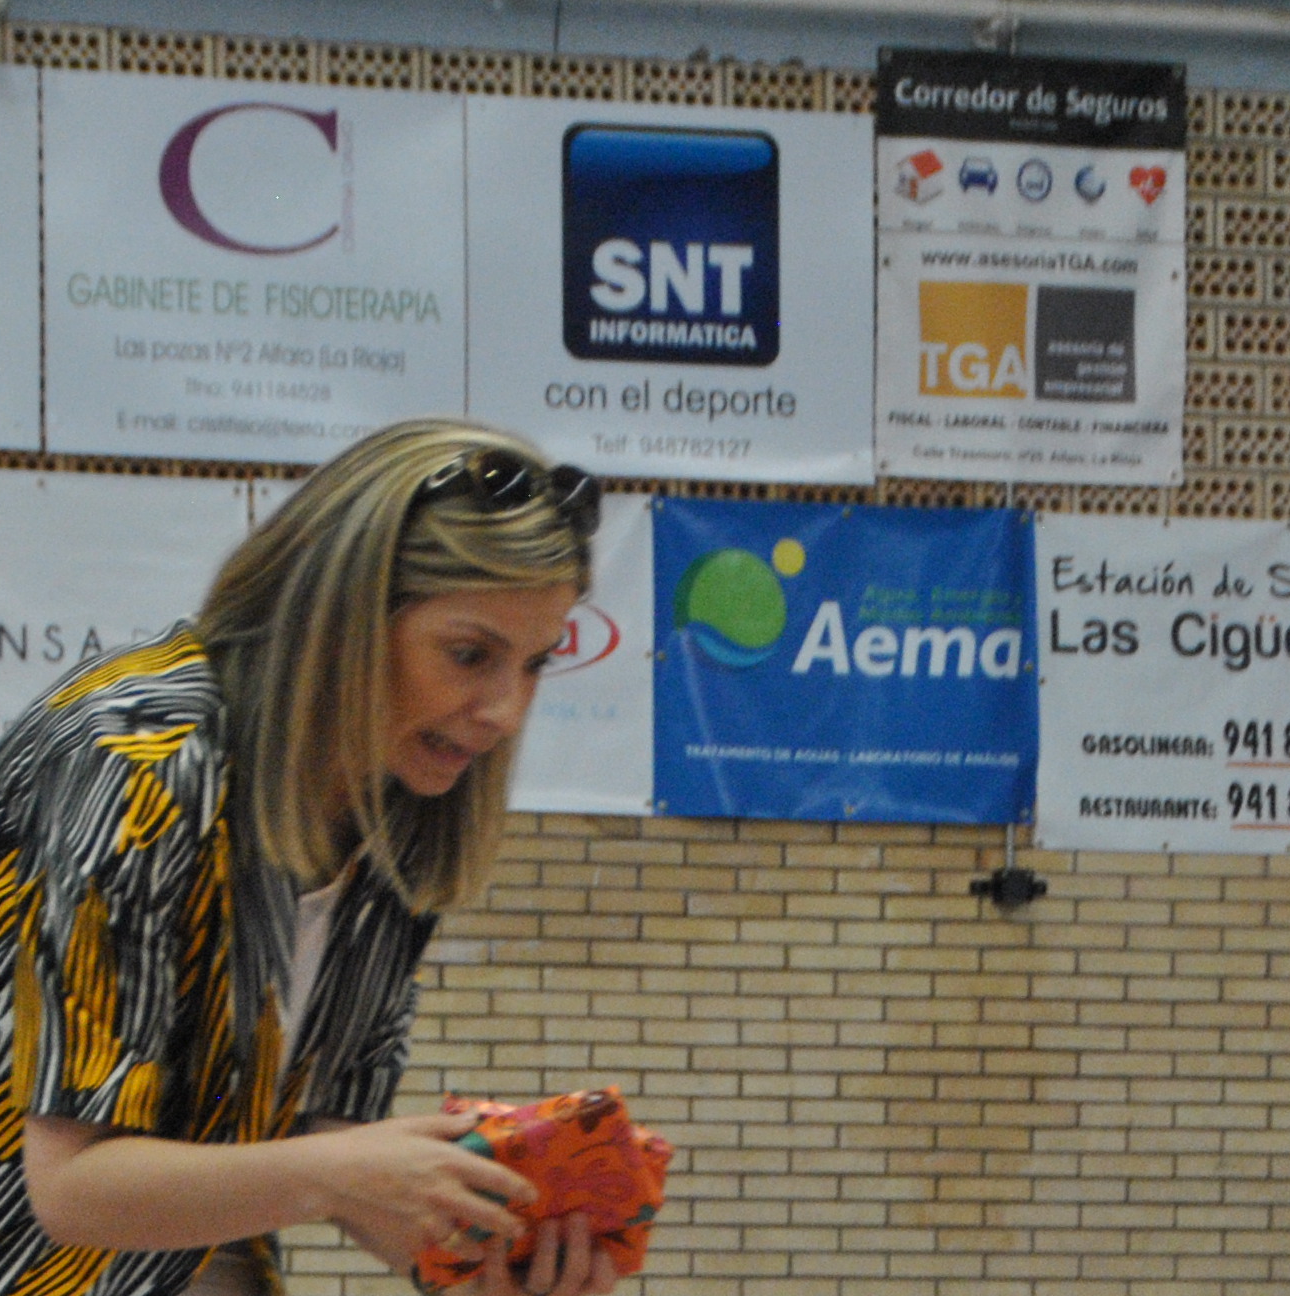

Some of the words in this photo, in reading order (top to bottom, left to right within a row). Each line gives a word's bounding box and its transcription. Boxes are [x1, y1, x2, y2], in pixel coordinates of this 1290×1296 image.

[894, 78, 1019, 112] Corredor
[1026, 84, 1056, 113] de
[1065, 87, 1168, 126] Seguros
[67, 272, 201, 314] GABINETE
[213, 280, 249, 316] DE
[265, 283, 441, 324] FISIOTERAPIA
[589, 237, 754, 316] SNT
[589, 317, 757, 349] INFORMATICA
[918, 341, 1028, 391] TGA
[544, 381, 607, 409] con
[621, 379, 650, 412] el
[663, 380, 797, 421] deporte
[888, 411, 931, 428] FISCAL
[944, 413, 1006, 429] LABORAL
[1018, 415, 1080, 432] CONTABLE
[1051, 556, 1194, 597] Estación
[1213, 563, 1254, 598] de
[791, 599, 1023, 679] Aema
[1050, 608, 1139, 656] Las
[1081, 732, 1214, 758] GASOLINERA:
[1223, 719, 1273, 758] 941
[1079, 795, 1217, 820] RESTAURANTE:
[1227, 781, 1277, 821] 941
